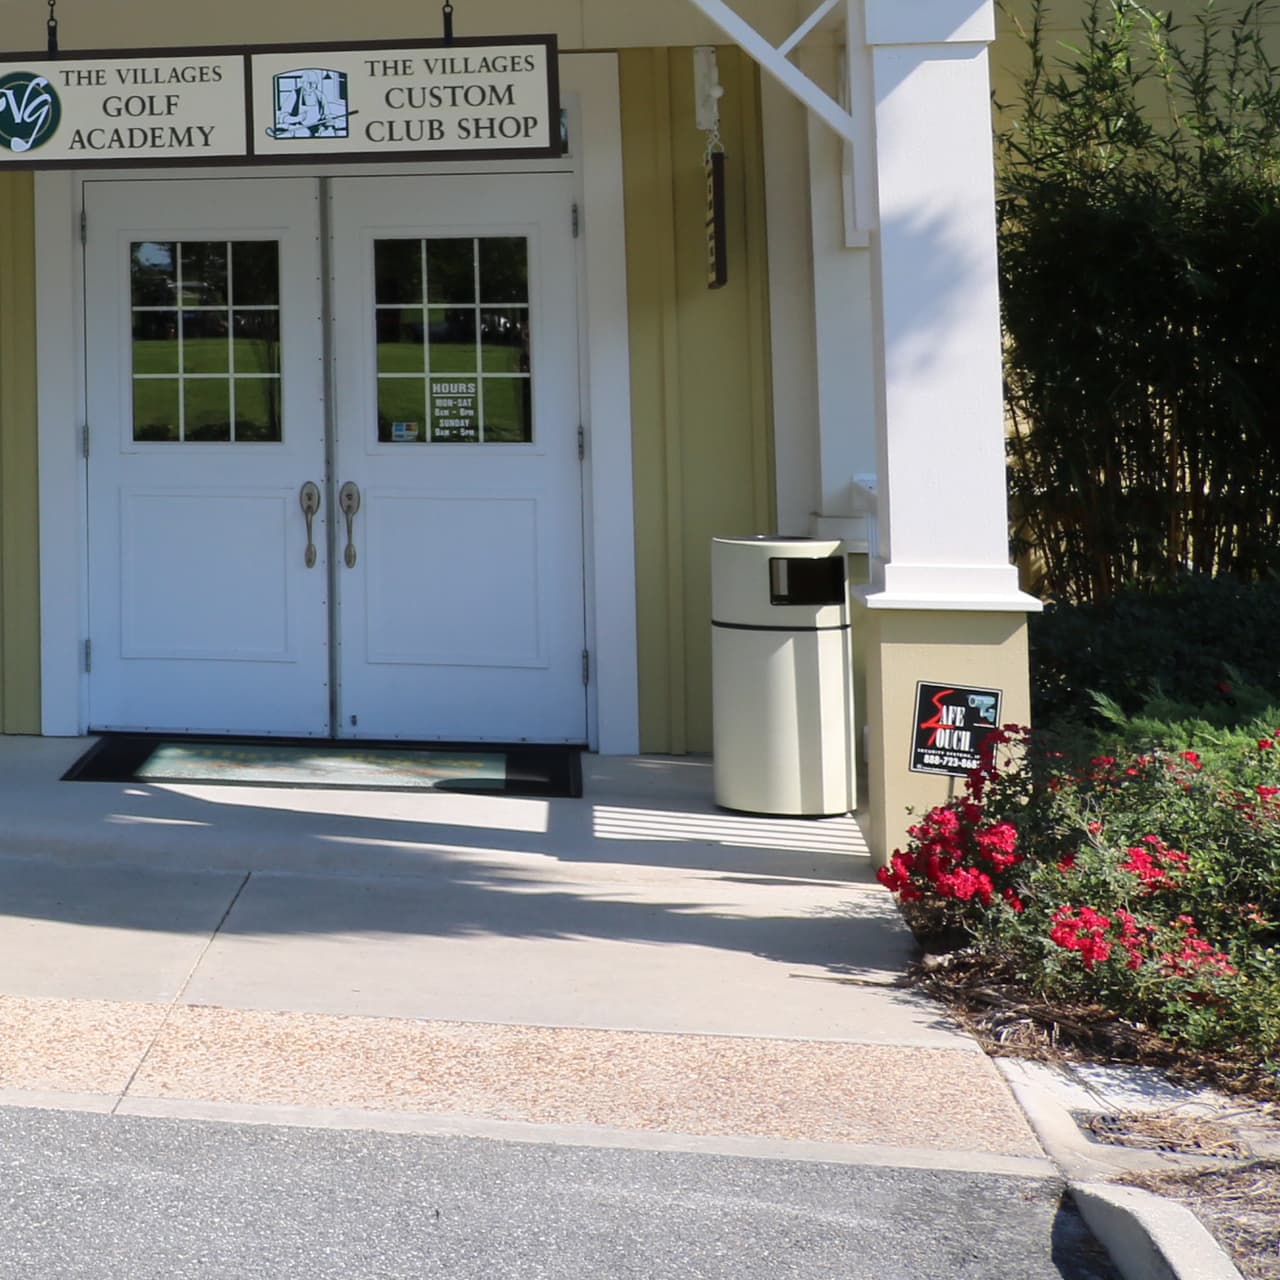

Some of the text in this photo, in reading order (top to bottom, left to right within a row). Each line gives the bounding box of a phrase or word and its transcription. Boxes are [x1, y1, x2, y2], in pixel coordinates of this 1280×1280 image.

[59, 65, 223, 87] THE VILLAGES
[364, 55, 536, 77] THE VILLAGES
[102, 94, 181, 118] GOLF
[384, 83, 515, 110] CUSTOM
[68, 125, 216, 151] ACADEMY
[365, 116, 539, 143] CLUB SHOP
[432, 383, 476, 393] HOURS
[439, 418, 470, 427] SUNDAY
[920, 689, 967, 728] SAFE
